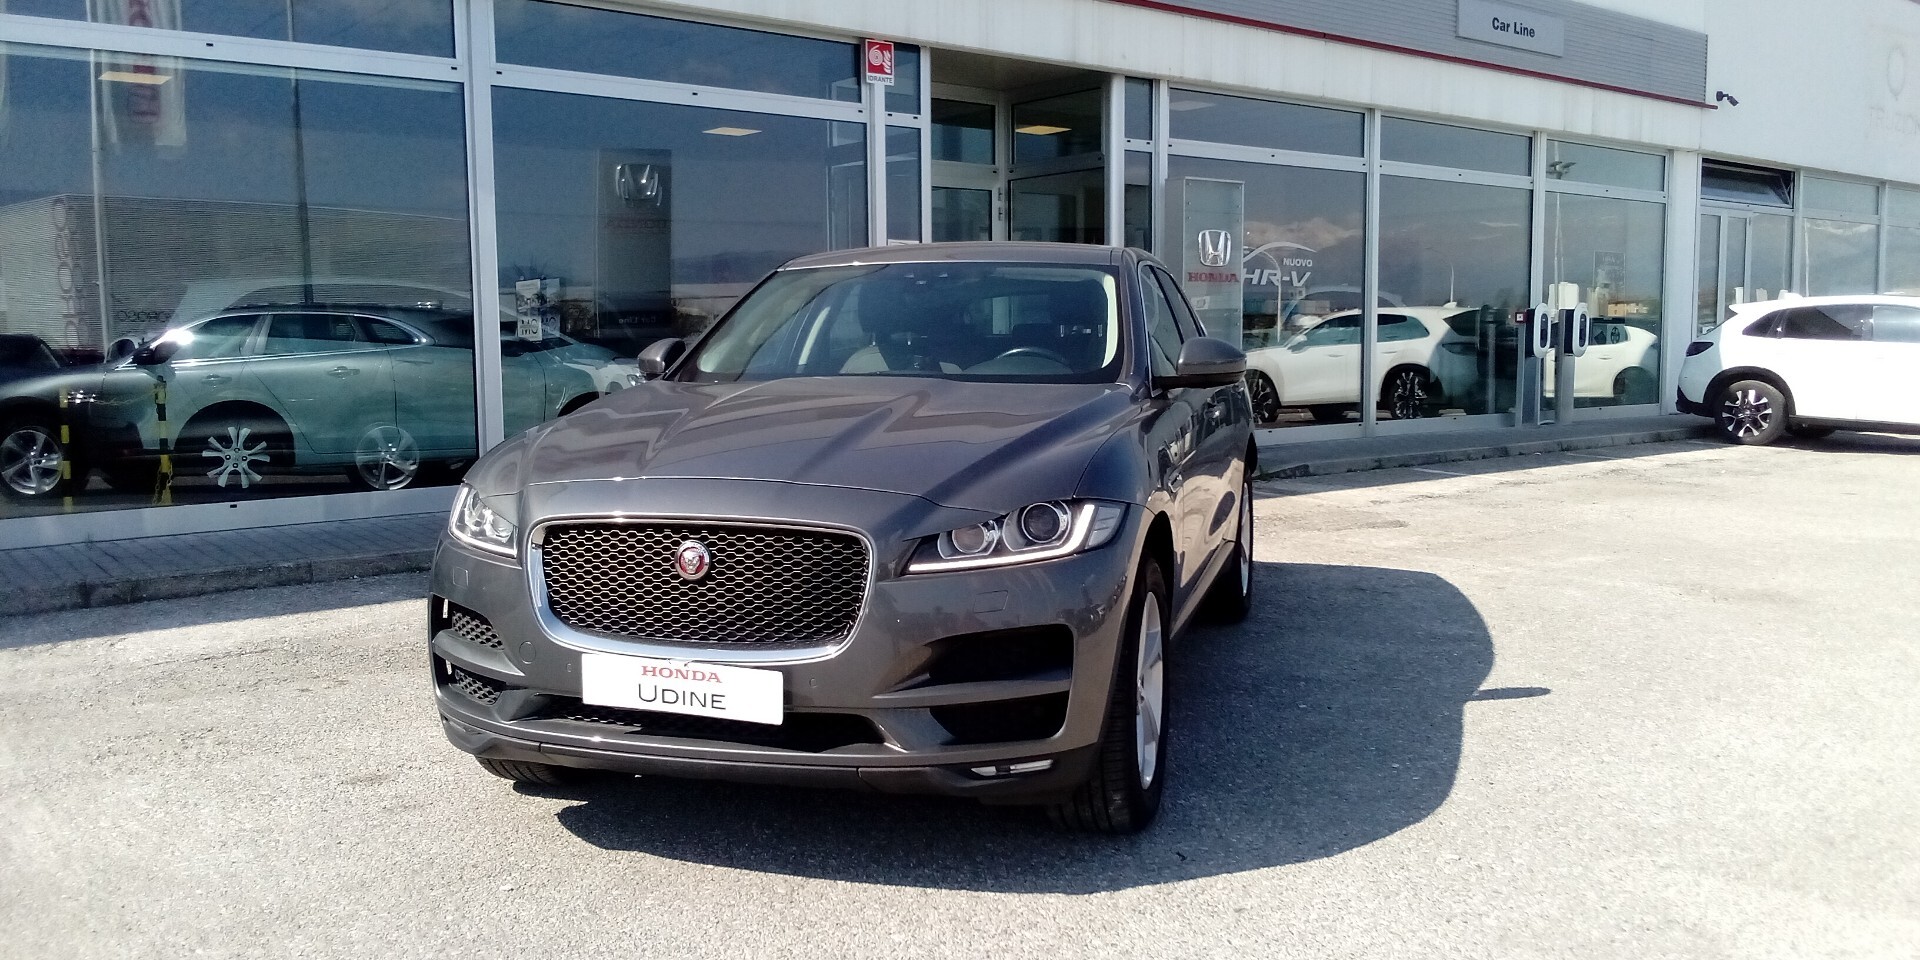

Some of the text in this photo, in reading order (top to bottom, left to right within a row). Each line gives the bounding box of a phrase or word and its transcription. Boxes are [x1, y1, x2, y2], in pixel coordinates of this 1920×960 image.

[1492, 17, 1535, 38] Car Line
[867, 75, 893, 84] IDRANTE
[1283, 257, 1313, 267] NUOVO
[1188, 271, 1240, 283] HONDA
[1243, 268, 1312, 287] HR-V
[641, 665, 723, 684] HONDA
[638, 683, 727, 710] UDINE
